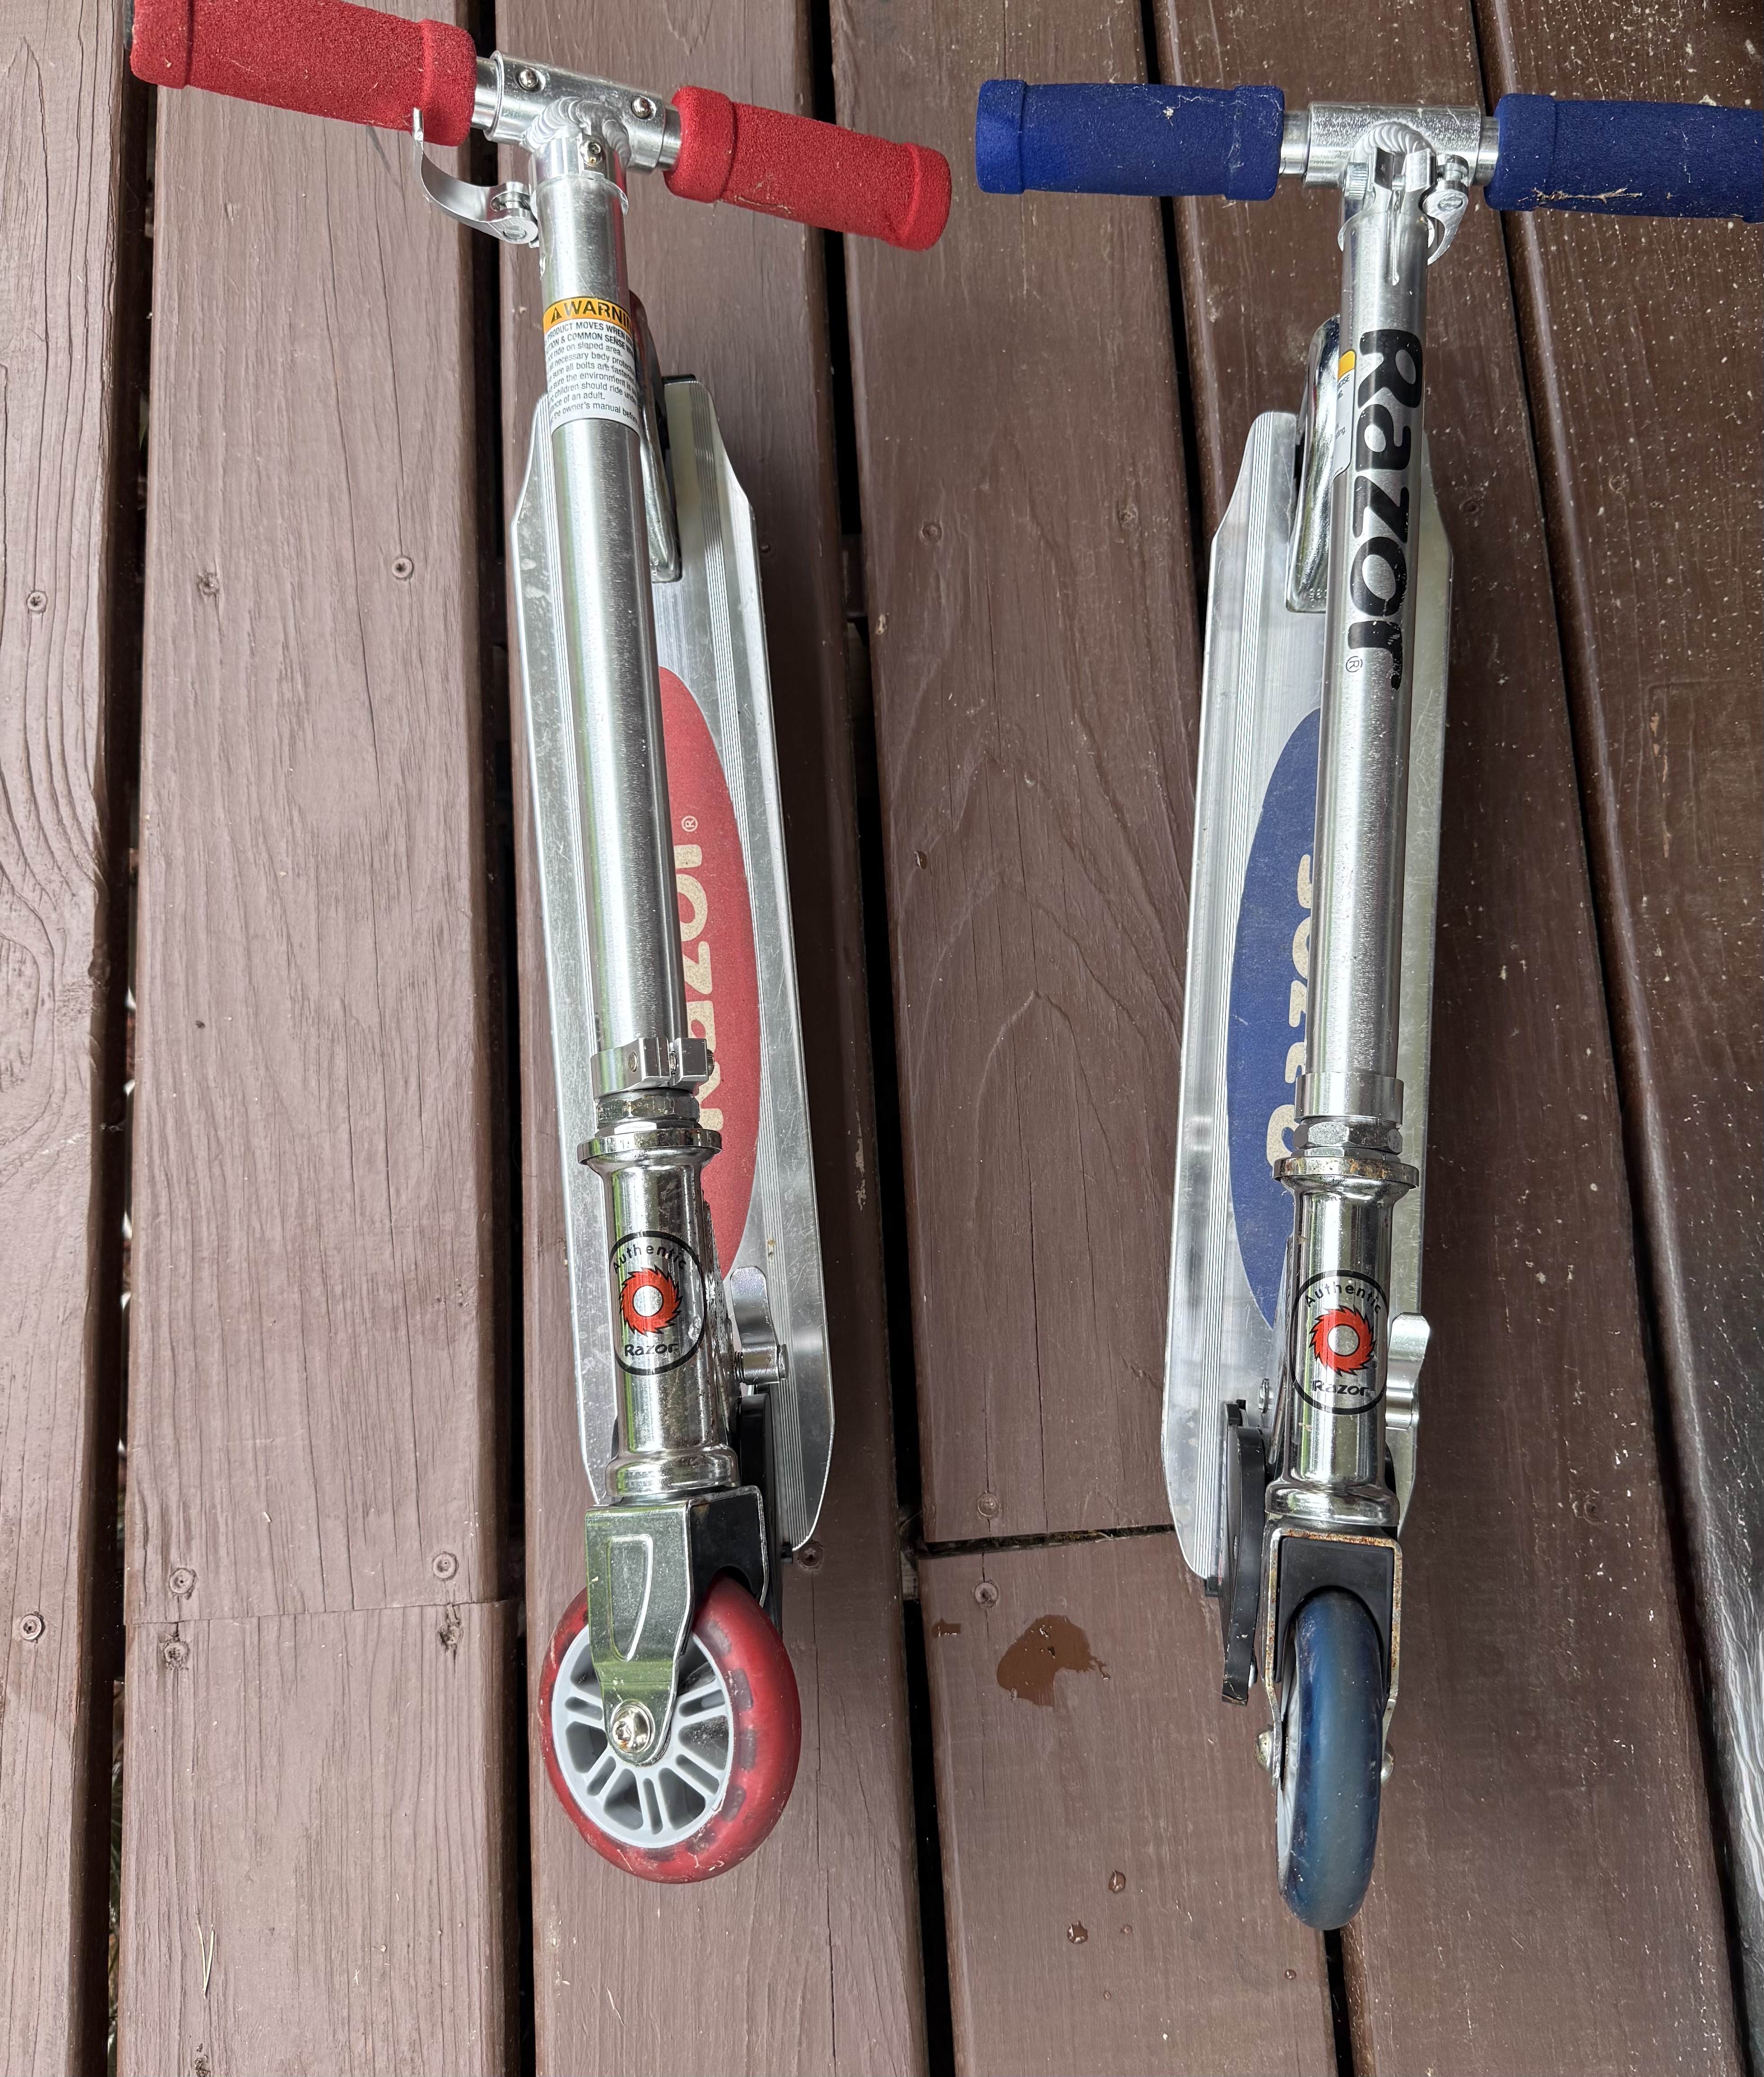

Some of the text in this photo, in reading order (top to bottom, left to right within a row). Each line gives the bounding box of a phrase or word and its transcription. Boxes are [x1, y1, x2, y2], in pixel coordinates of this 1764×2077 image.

[564, 300, 632, 333] WARNIN
[547, 323, 574, 342] PRODUCT
[576, 322, 604, 331] MOVES
[561, 335, 565, 344] &
[567, 332, 603, 341] COMMON
[605, 335, 625, 349] SENSE
[554, 347, 564, 357] ride
[578, 341, 603, 350] sloped
[606, 345, 622, 357] area.
[555, 353, 589, 366] necessary
[591, 352, 610, 362] body
[553, 368, 564, 379] sure
[576, 362, 595, 370] bolts
[554, 378, 564, 389] sure
[567, 374, 577, 382] the
[580, 372, 625, 388] environment
[555, 384, 579, 398] children
[581, 381, 607, 390] should
[610, 385, 623, 395] ride
[563, 394, 569, 403] of
[583, 391, 605, 400] adult.
[563, 401, 590, 414] owner's
[593, 402, 621, 413] manual
[1347, 329, 1423, 690] Razor
[613, 1244, 687, 1273] Authentic
[1305, 1281, 1381, 1314] Authentic
[625, 1343, 678, 1357] Razor
[1313, 1379, 1369, 1396] Razor
